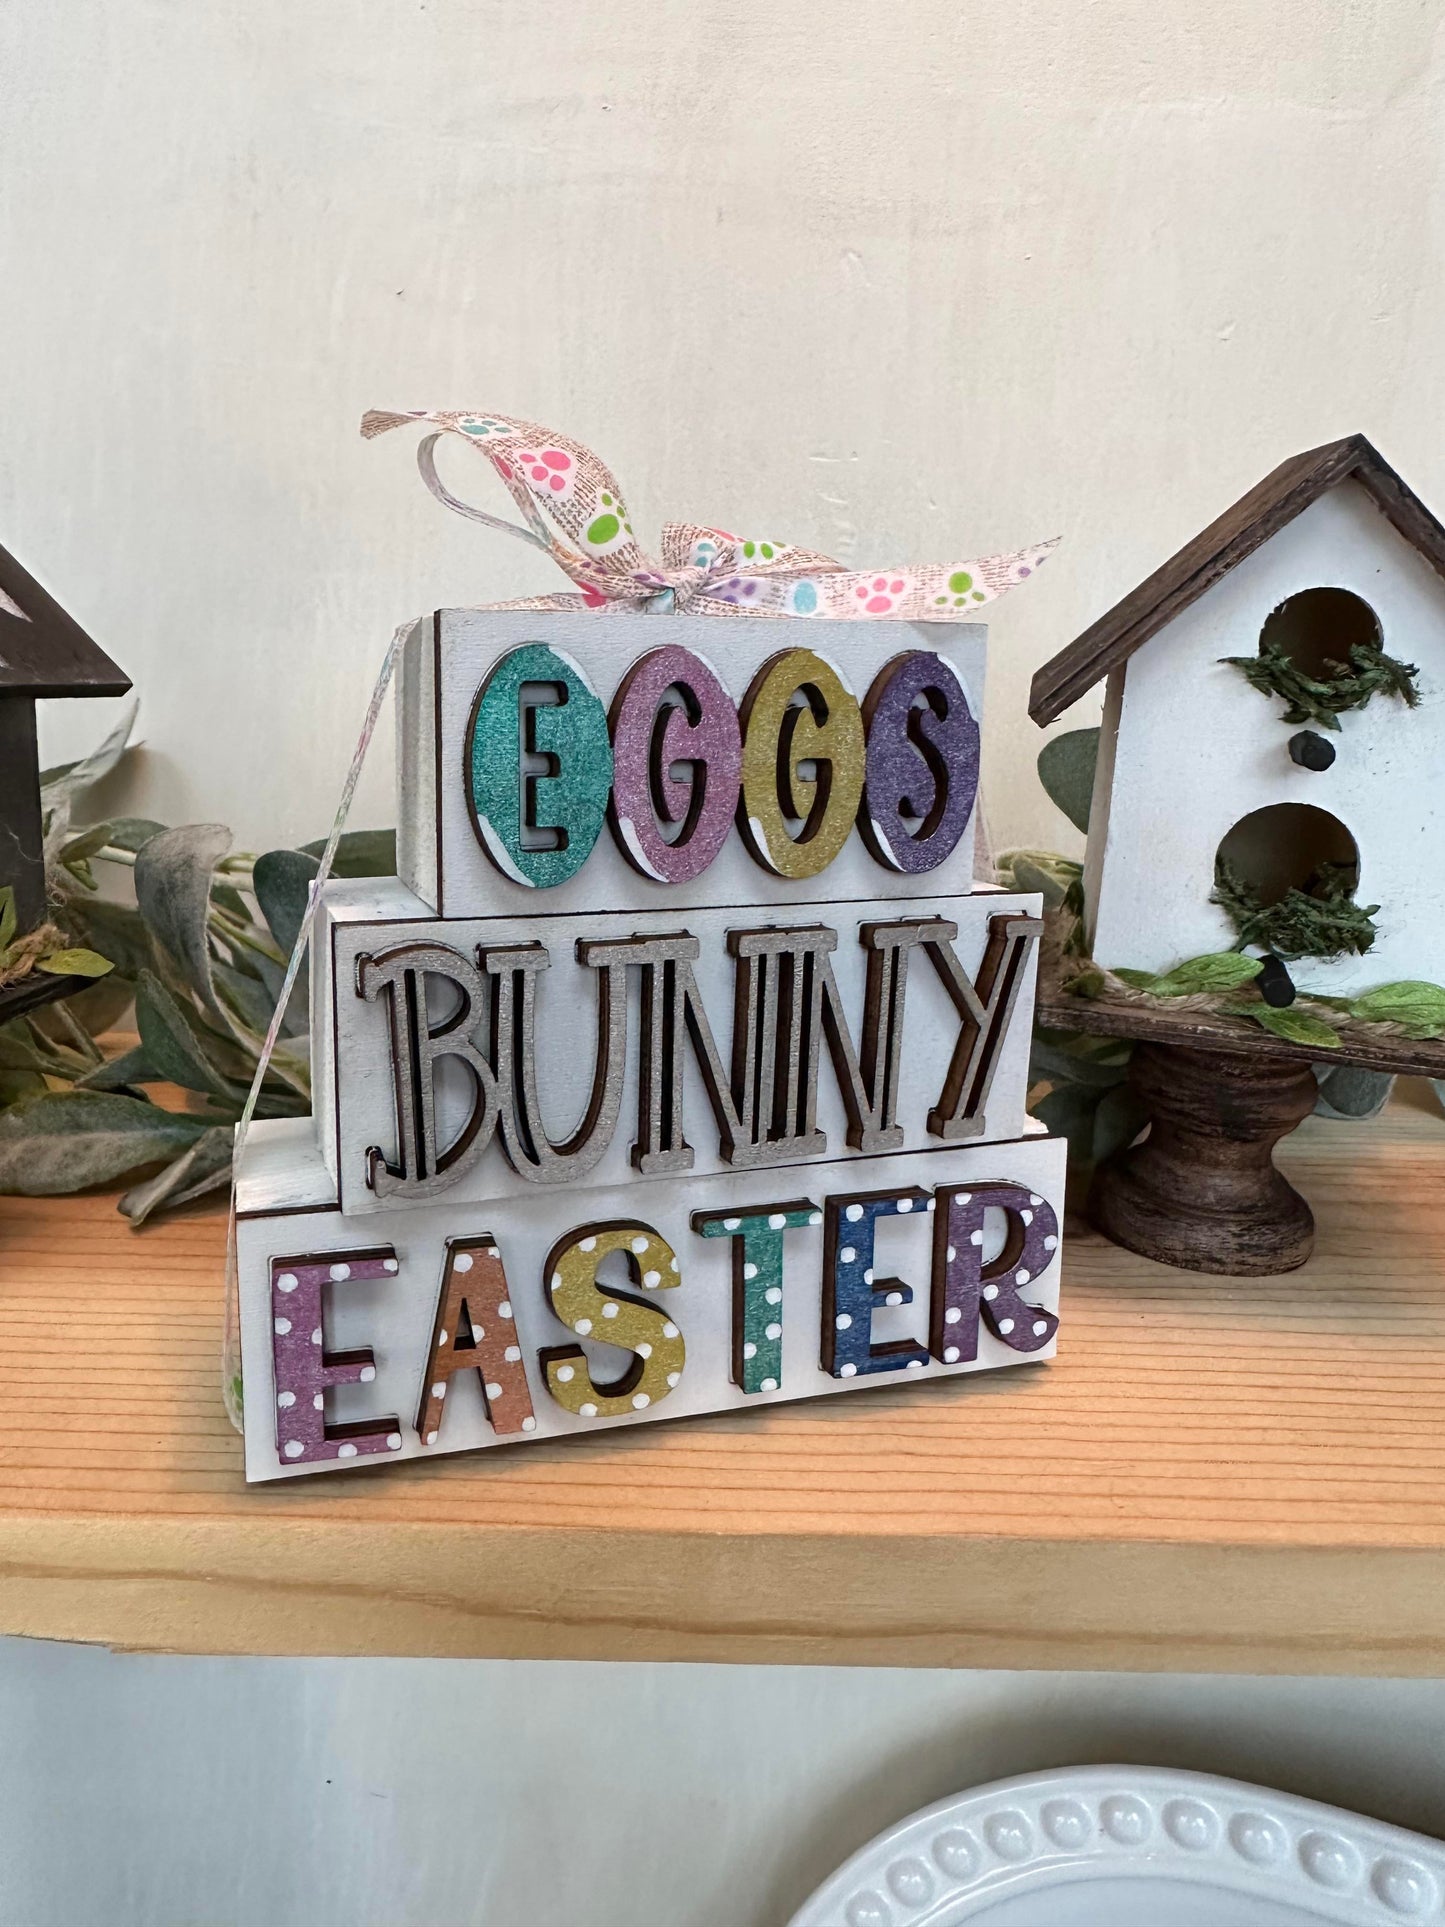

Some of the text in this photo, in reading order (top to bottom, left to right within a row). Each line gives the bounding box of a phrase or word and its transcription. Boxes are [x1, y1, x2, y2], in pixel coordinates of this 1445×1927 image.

[517, 678, 951, 854] EGGS
[356, 911, 1044, 1198] BUNNY
[271, 1179, 1060, 1466] EASTER
